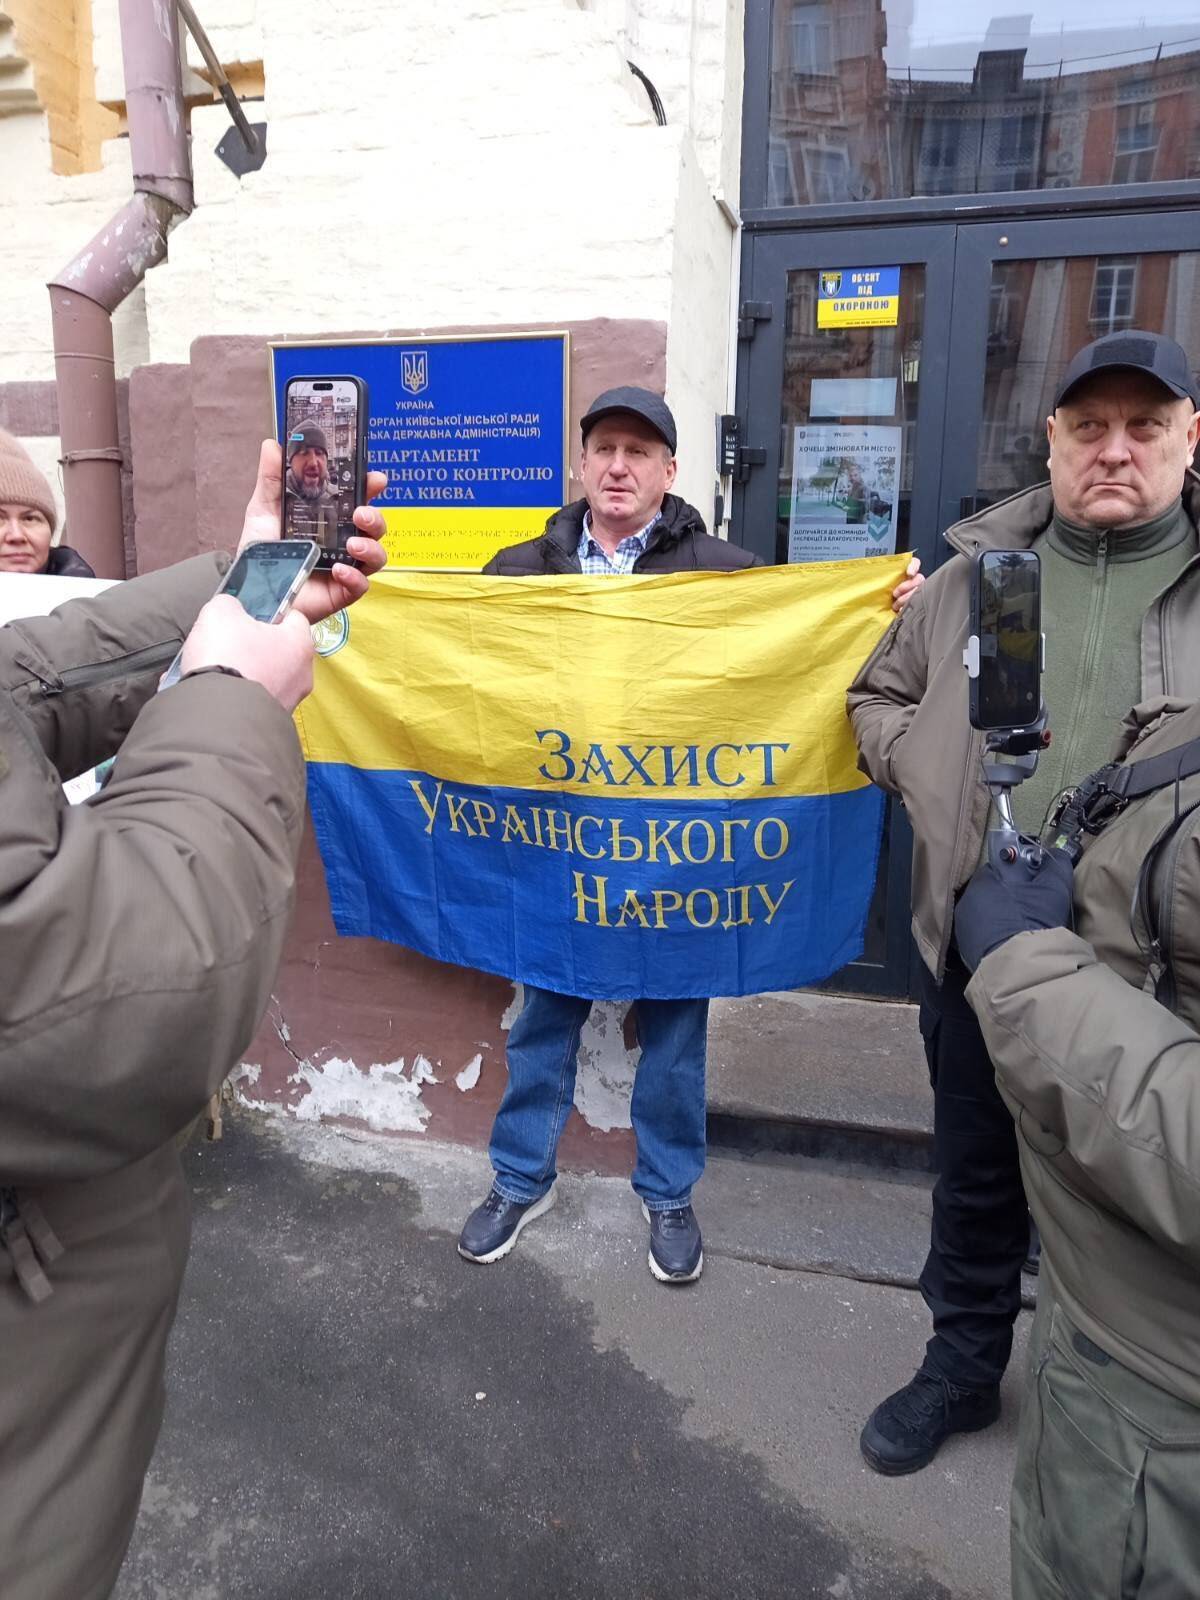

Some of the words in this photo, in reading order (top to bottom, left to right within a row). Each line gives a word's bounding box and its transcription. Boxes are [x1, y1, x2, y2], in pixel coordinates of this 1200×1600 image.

[858, 285, 873, 295] ПІД
[833, 300, 889, 311] ОХОРОНОЮ
[395, 400, 434, 410] УКРАЇНА
[369, 417, 402, 427] ОРГАН
[405, 414, 461, 426] КИЇВСЬКОЇ
[463, 412, 508, 425] МІСЬКОЇ
[510, 413, 540, 424] РАДИ
[367, 430, 391, 440] ЬКА
[393, 429, 452, 440] ДЕРЖАВНА
[454, 427, 541, 439] АДМІНІСТРАЦІЯ)
[367, 449, 481, 463] ЕПАРТАМЕНТ
[452, 467, 553, 481] КОНТРОЛЮ
[417, 486, 476, 500] КИЄВА
